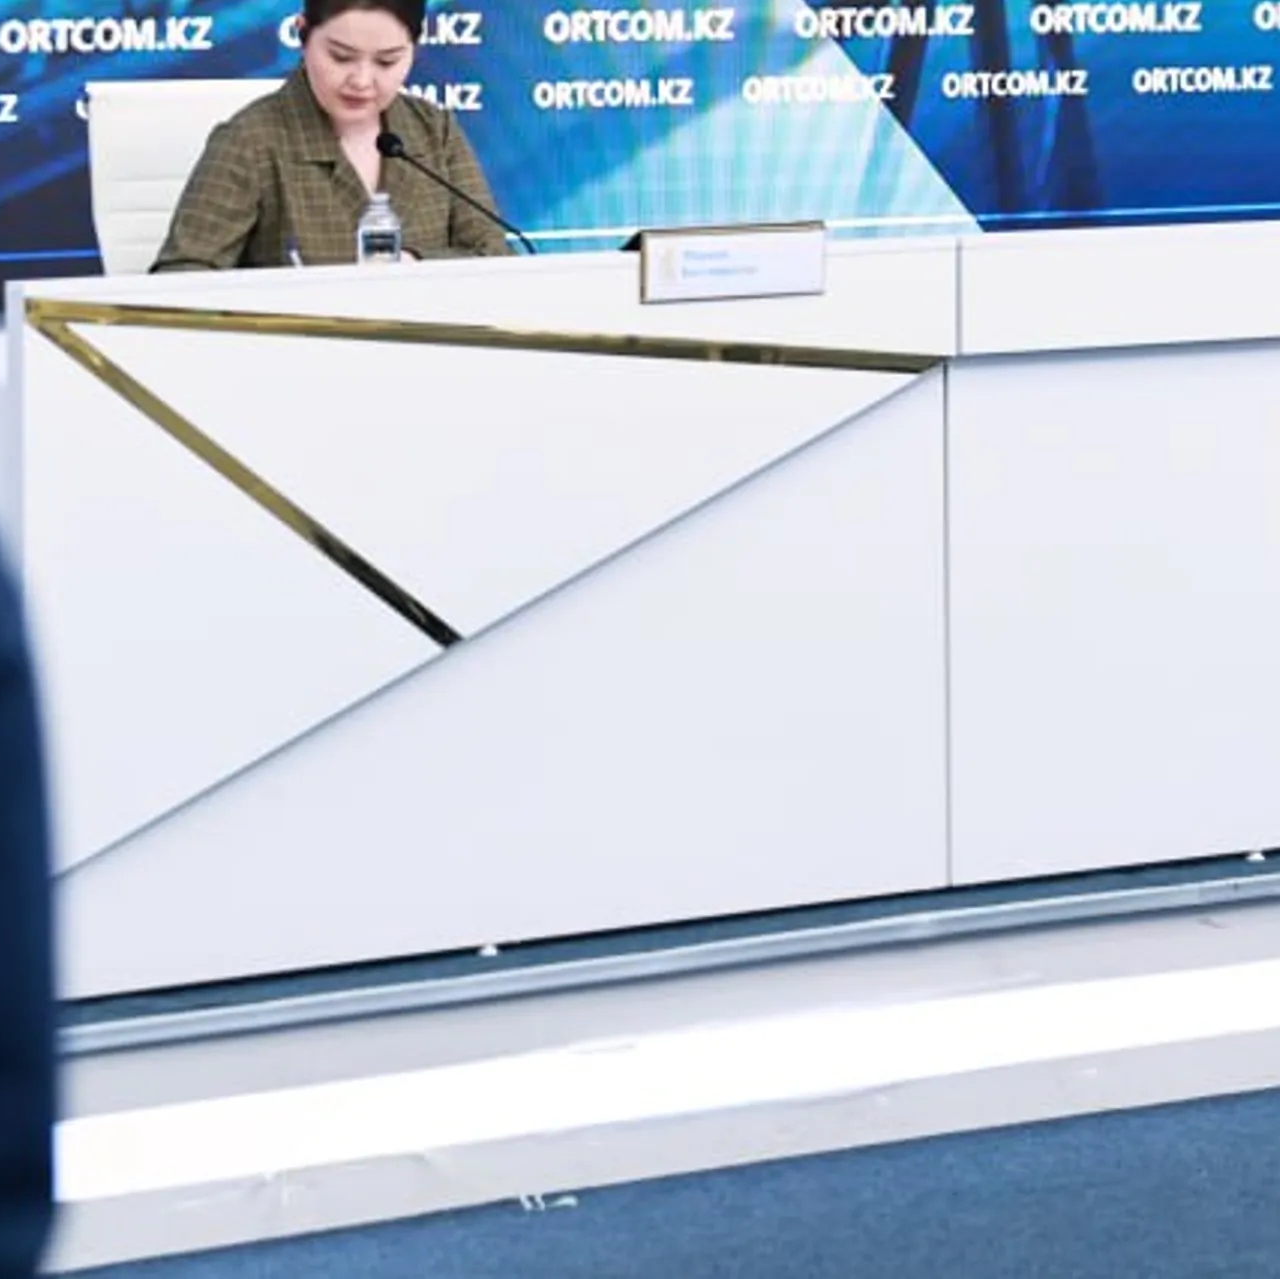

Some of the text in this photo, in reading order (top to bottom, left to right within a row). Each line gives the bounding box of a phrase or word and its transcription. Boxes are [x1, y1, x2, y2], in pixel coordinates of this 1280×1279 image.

[543, 6, 737, 44] ORTCOM.KZ
[794, 4, 975, 38] ORTCOM.KZ
[1029, 2, 1201, 34] ORTCOM.KZ
[533, 78, 693, 109] ORTCOM.KZ
[742, 72, 894, 101] ORTCOM.KZ
[942, 69, 1087, 98] ORTCOM.KZ
[1133, 66, 1272, 93] ORTCOM.KZ
